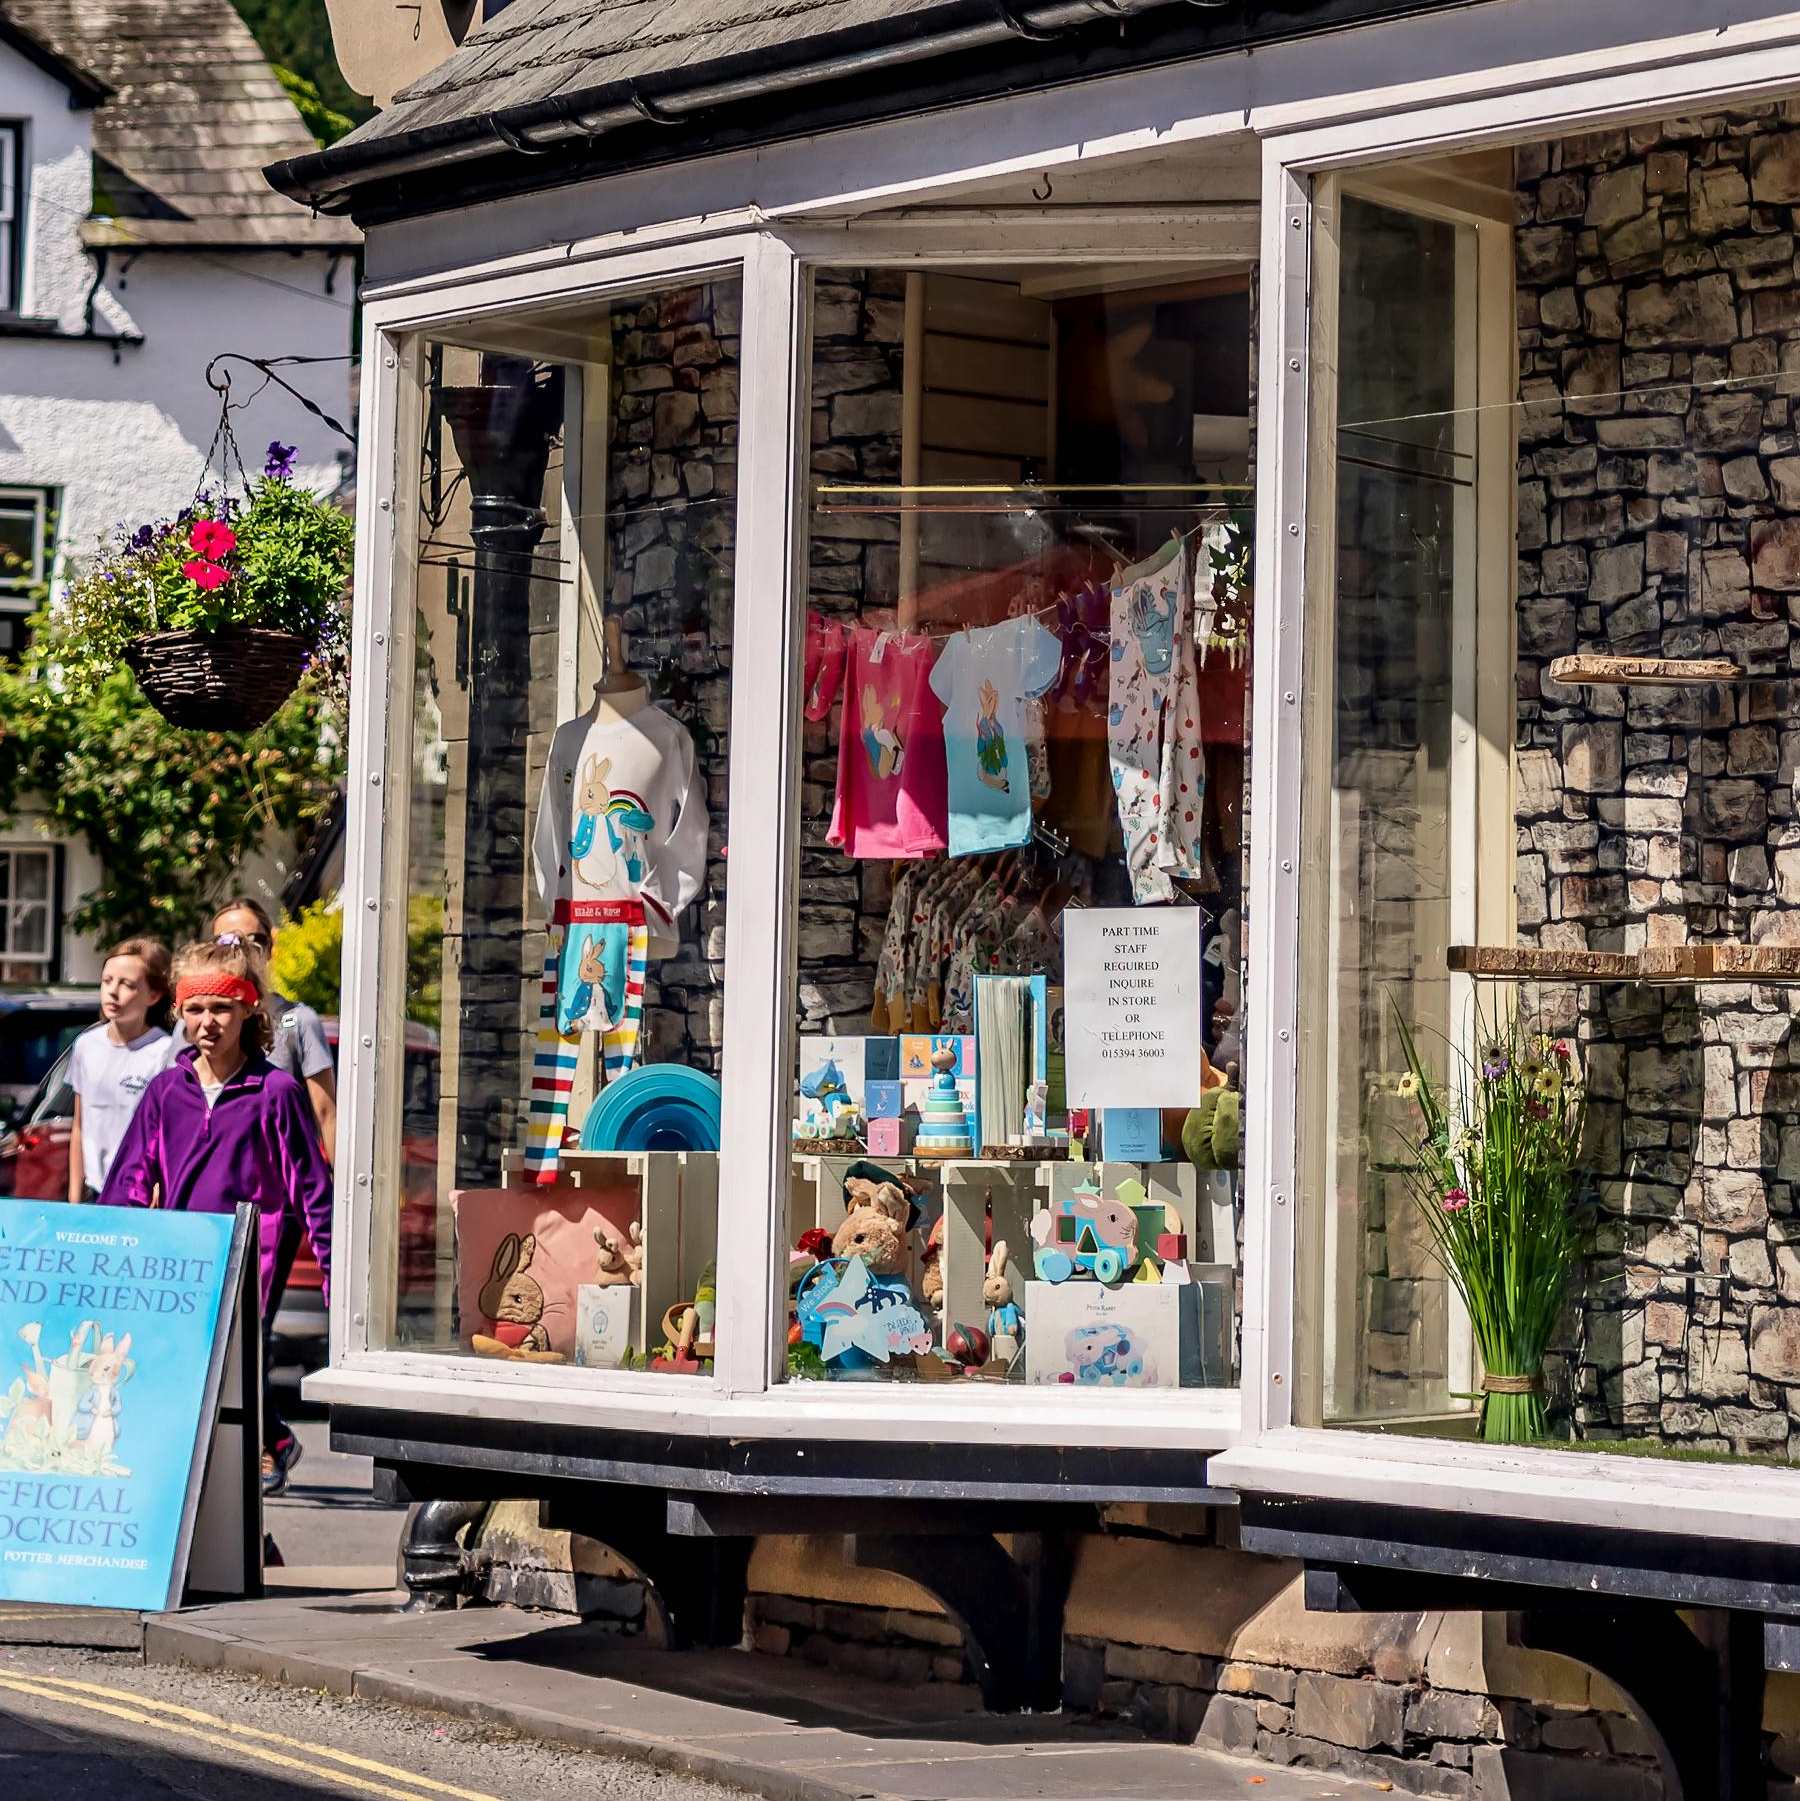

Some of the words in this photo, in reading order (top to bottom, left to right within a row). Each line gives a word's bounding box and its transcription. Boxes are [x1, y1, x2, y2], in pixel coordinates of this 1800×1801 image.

[1102, 926, 1130, 937] PART
[1132, 926, 1160, 937] TIME
[1114, 943, 1148, 954] STAFF
[1109, 978, 1155, 990] INQUIRE
[1108, 996, 1122, 1006] IN
[1122, 996, 1157, 1007] STORE
[1124, 1013, 1141, 1024] OR
[1101, 1030, 1165, 1042] TELEPHONE
[1101, 1048, 1136, 1059] 015394
[1137, 1048, 1166, 1059] 36003
[55, 1231, 117, 1246] WELCOME
[120, 1235, 140, 1248] TO
[89, 1252, 214, 1284] RABBIT
[813, 1279, 836, 1300] Stock
[3, 1550, 53, 1565] POTTER
[56, 1553, 149, 1571] MERCHANDISE
